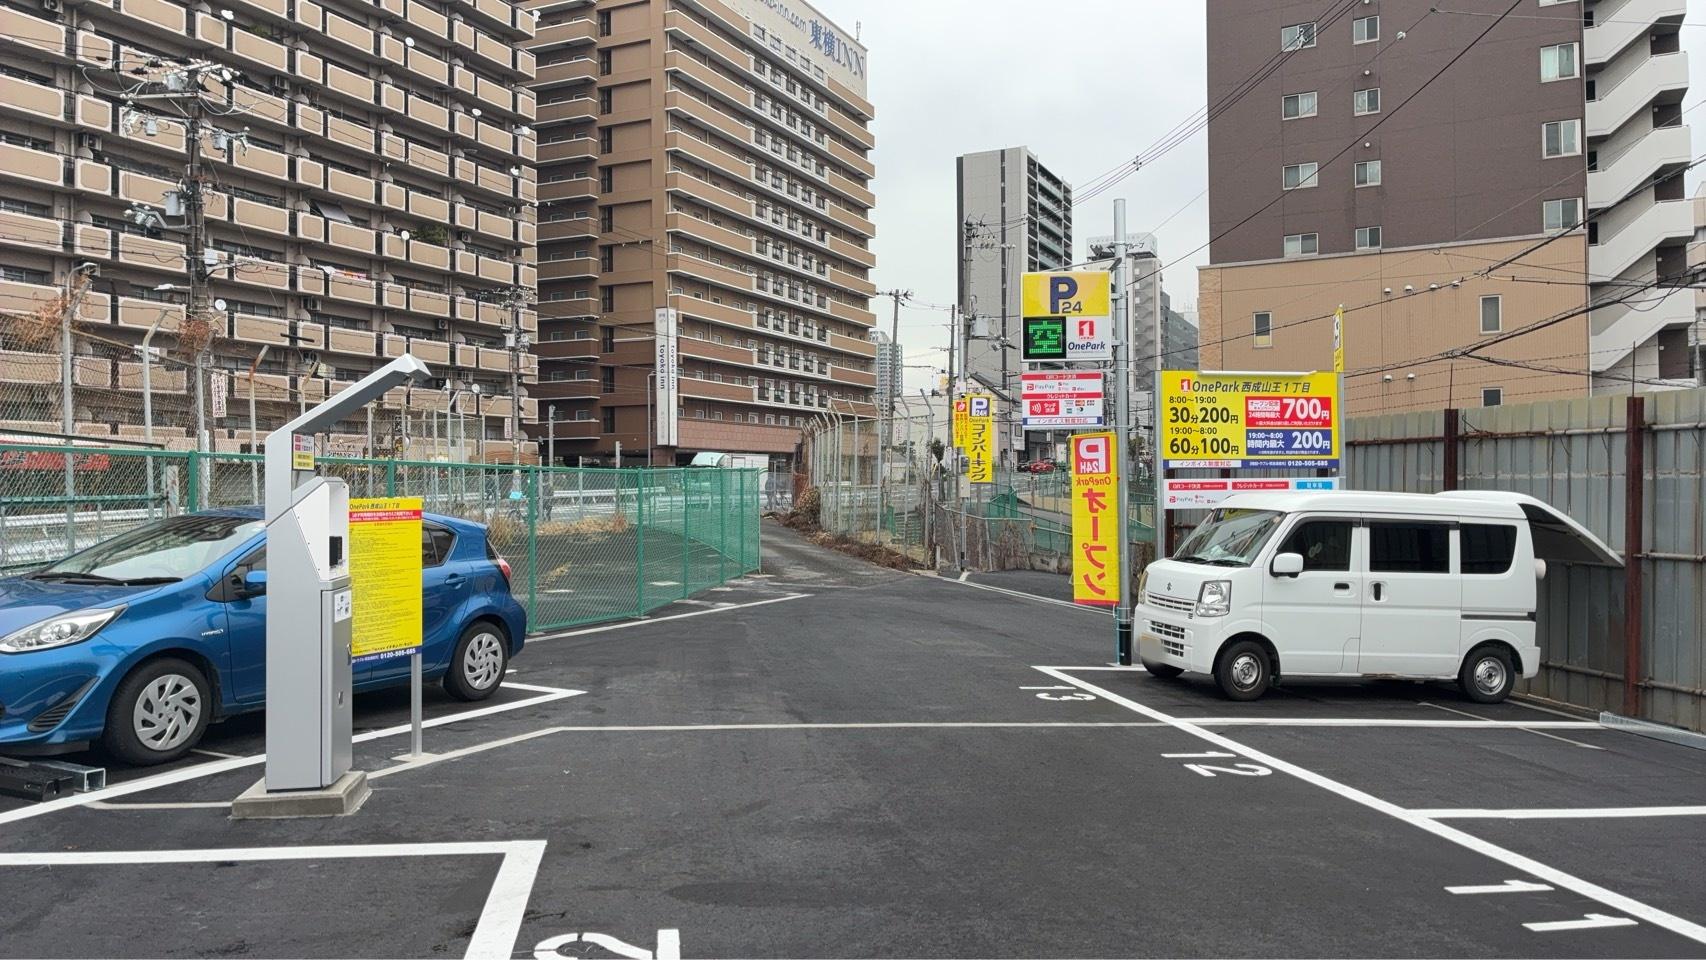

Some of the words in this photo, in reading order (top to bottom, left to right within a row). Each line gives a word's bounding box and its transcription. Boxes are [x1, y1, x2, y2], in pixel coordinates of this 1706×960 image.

[1050, 276, 1078, 314] P
[1061, 301, 1082, 314] 24
[1029, 321, 1062, 354] 空
[1068, 341, 1105, 351] OnePark
[1192, 380, 1240, 393] OnePark
[971, 397, 989, 416] P
[1169, 396, 1217, 404] 8:00～19:00
[1169, 407, 1239, 424] 30分200円
[1282, 398, 1330, 420] 700円
[1170, 427, 1218, 435] 19:00～8:00
[1169, 437, 1239, 454] 60分100円
[1247, 440, 1285, 449] 時間内最大
[1291, 431, 1331, 449] 200円
[971, 424, 986, 481] コインパーキング
[1160, 750, 1273, 777] 12
